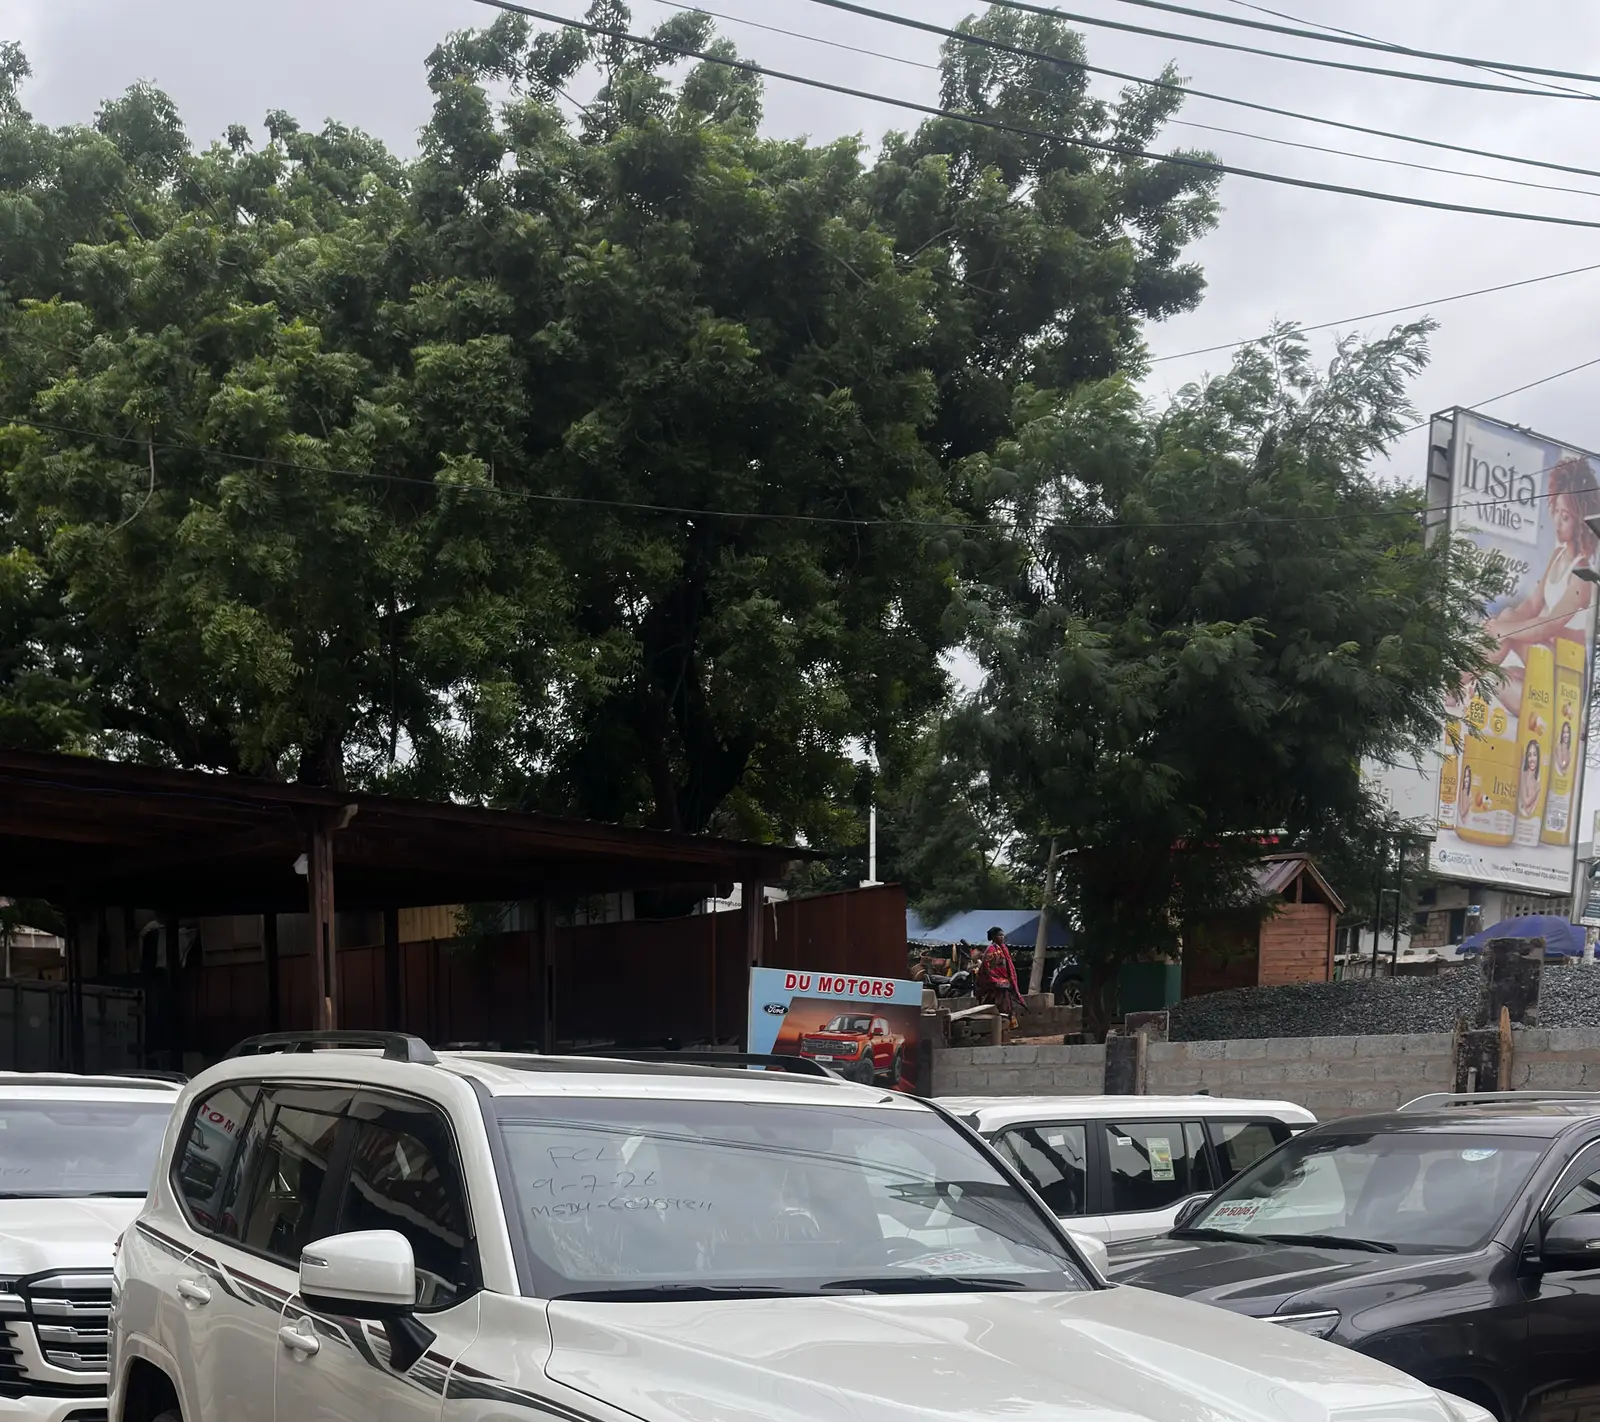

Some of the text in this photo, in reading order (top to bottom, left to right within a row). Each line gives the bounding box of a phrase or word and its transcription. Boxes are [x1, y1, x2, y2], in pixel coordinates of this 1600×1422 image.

[1463, 442, 1536, 508] Insta
[1477, 498, 1522, 530] white
[1470, 701, 1485, 713] EGG
[1492, 775, 1517, 799] Insta
[784, 972, 896, 998] DU MOTORS
[767, 1004, 785, 1014] Ford
